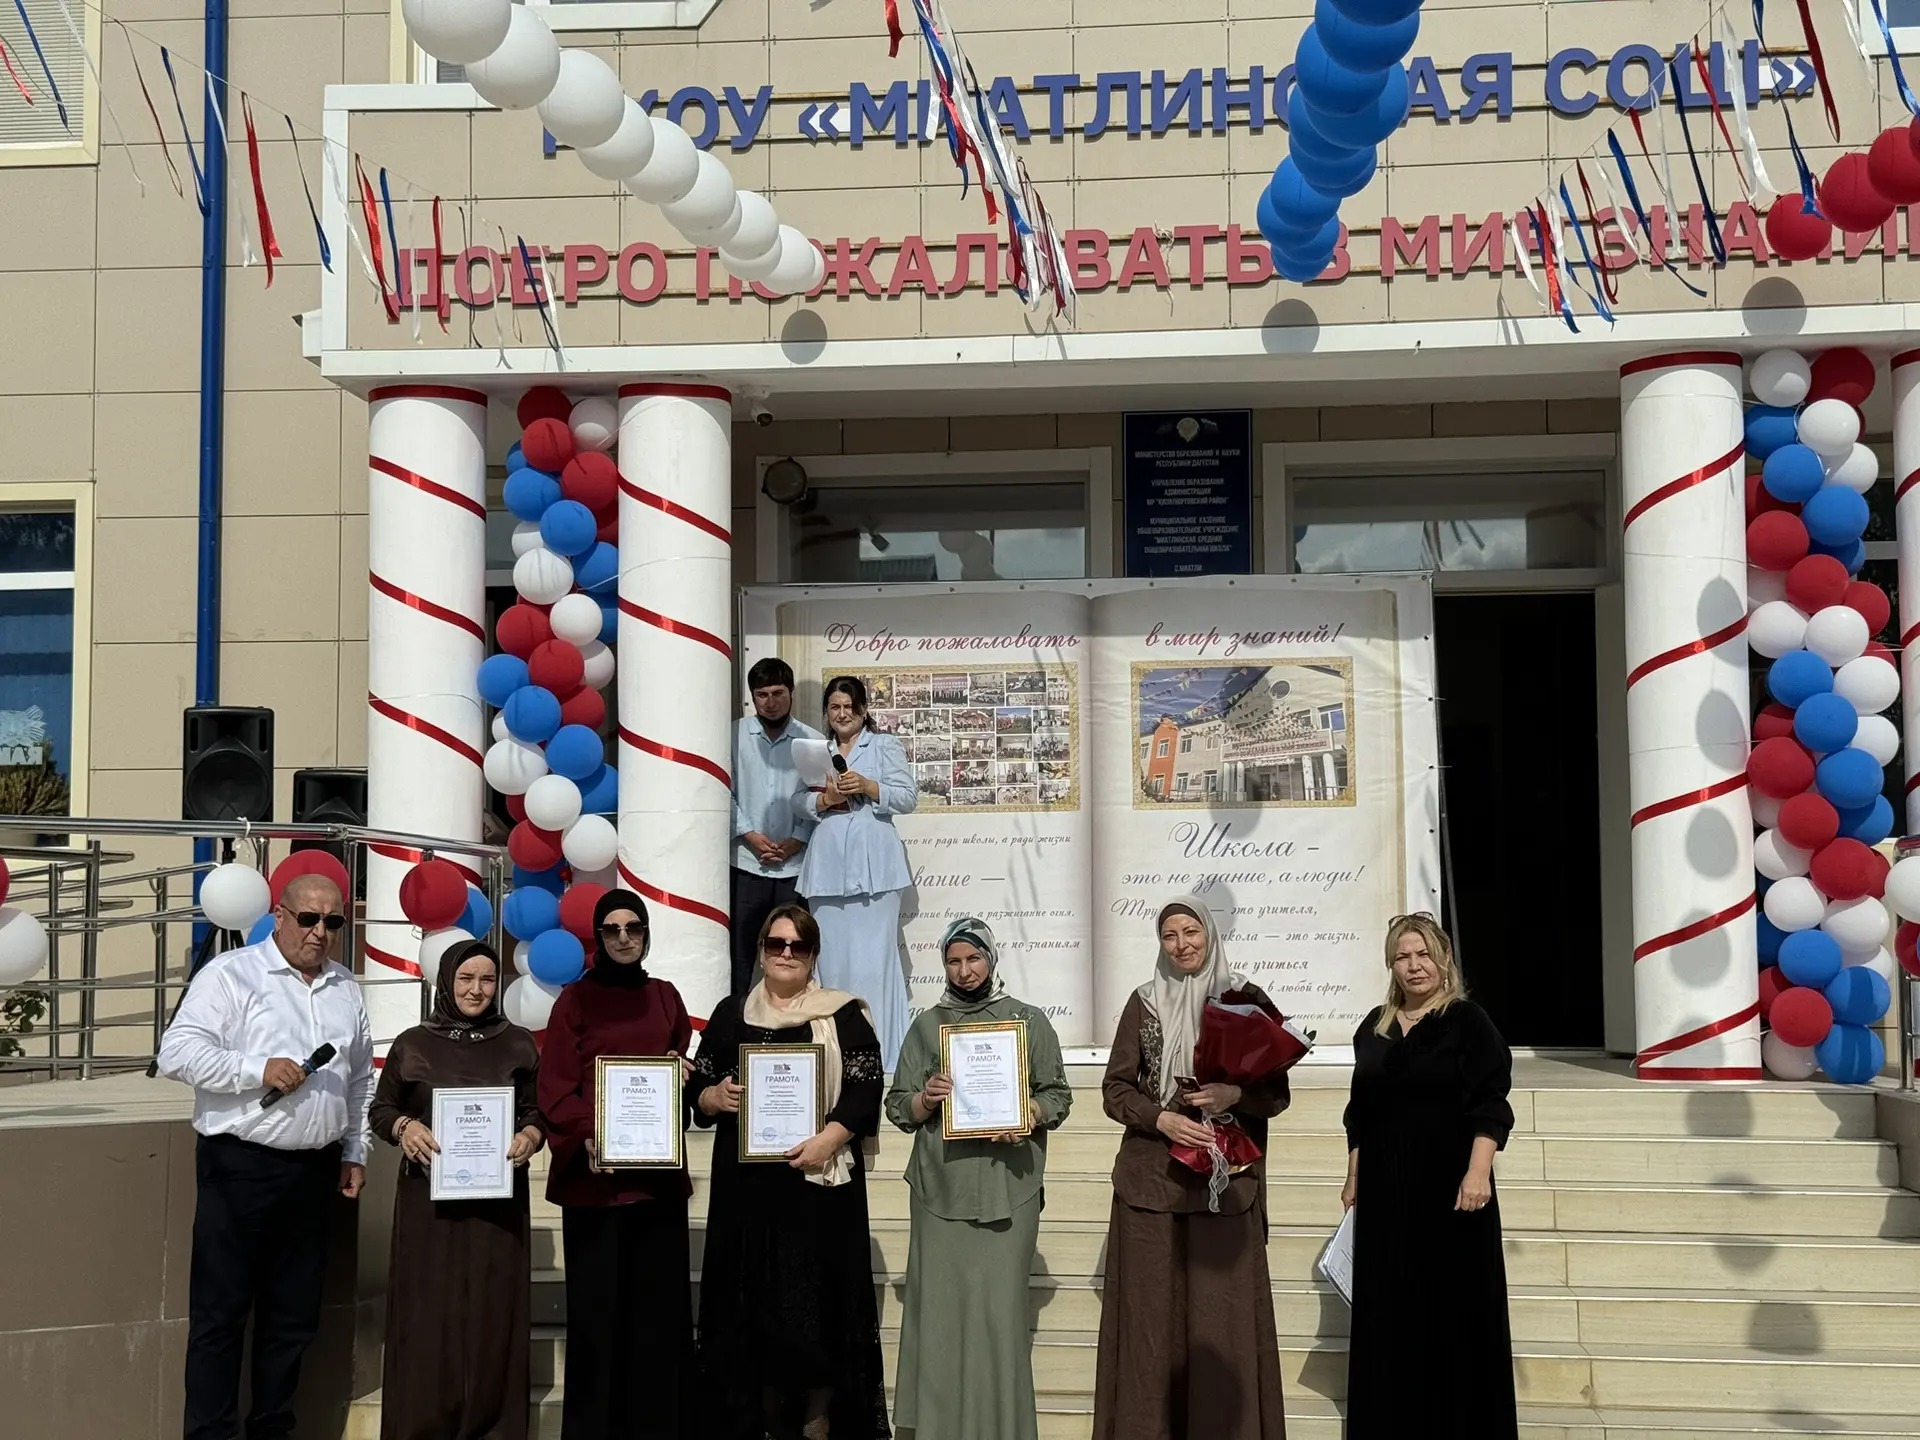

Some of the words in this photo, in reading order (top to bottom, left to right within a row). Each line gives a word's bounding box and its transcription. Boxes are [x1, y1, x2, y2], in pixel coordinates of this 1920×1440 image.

[543, 85, 774, 153] ОУ
[799, 52, 1513, 144] «МАТЛИНАЯ
[1545, 39, 1817, 114] СОШ»
[387, 242, 668, 321] ДОБРО
[696, 224, 1273, 300] ПЖАЛВАТЬ
[1381, 211, 1564, 277] МИР
[1592, 202, 1920, 269] ЗНАИ
[824, 623, 910, 661] Добро
[917, 624, 1081, 651] пожаловать
[1145, 622, 1164, 647] в
[1165, 626, 1221, 655] мир
[1223, 622, 1346, 657] знаний!
[934, 837, 959, 848] ради
[962, 834, 998, 846] школы,
[1010, 836, 1034, 848] ради
[1038, 836, 1071, 847] жизни
[1168, 821, 1296, 859] Школа
[1121, 871, 1162, 886] это
[1167, 869, 1191, 885] не
[1191, 869, 1273, 894] здание,
[1278, 869, 1292, 883] а
[1295, 865, 1366, 893] люди!
[986, 910, 1047, 923] разжигание
[1050, 910, 1076, 918] огня.
[1230, 904, 1254, 917] это
[1257, 904, 1318, 920] учителя,
[1286, 932, 1309, 941] это
[1314, 932, 1360, 945] жизнь.
[1025, 941, 1081, 953] знаниям
[1252, 960, 1309, 975] учиться
[1268, 980, 1275, 992] в
[1277, 979, 1313, 993] любой
[1316, 982, 1351, 996] сфере.
[1328, 1008, 1337, 1021] в
[766, 1076, 800, 1084] ГРАМОТА
[456, 1116, 492, 1124] ГРАМОТА
